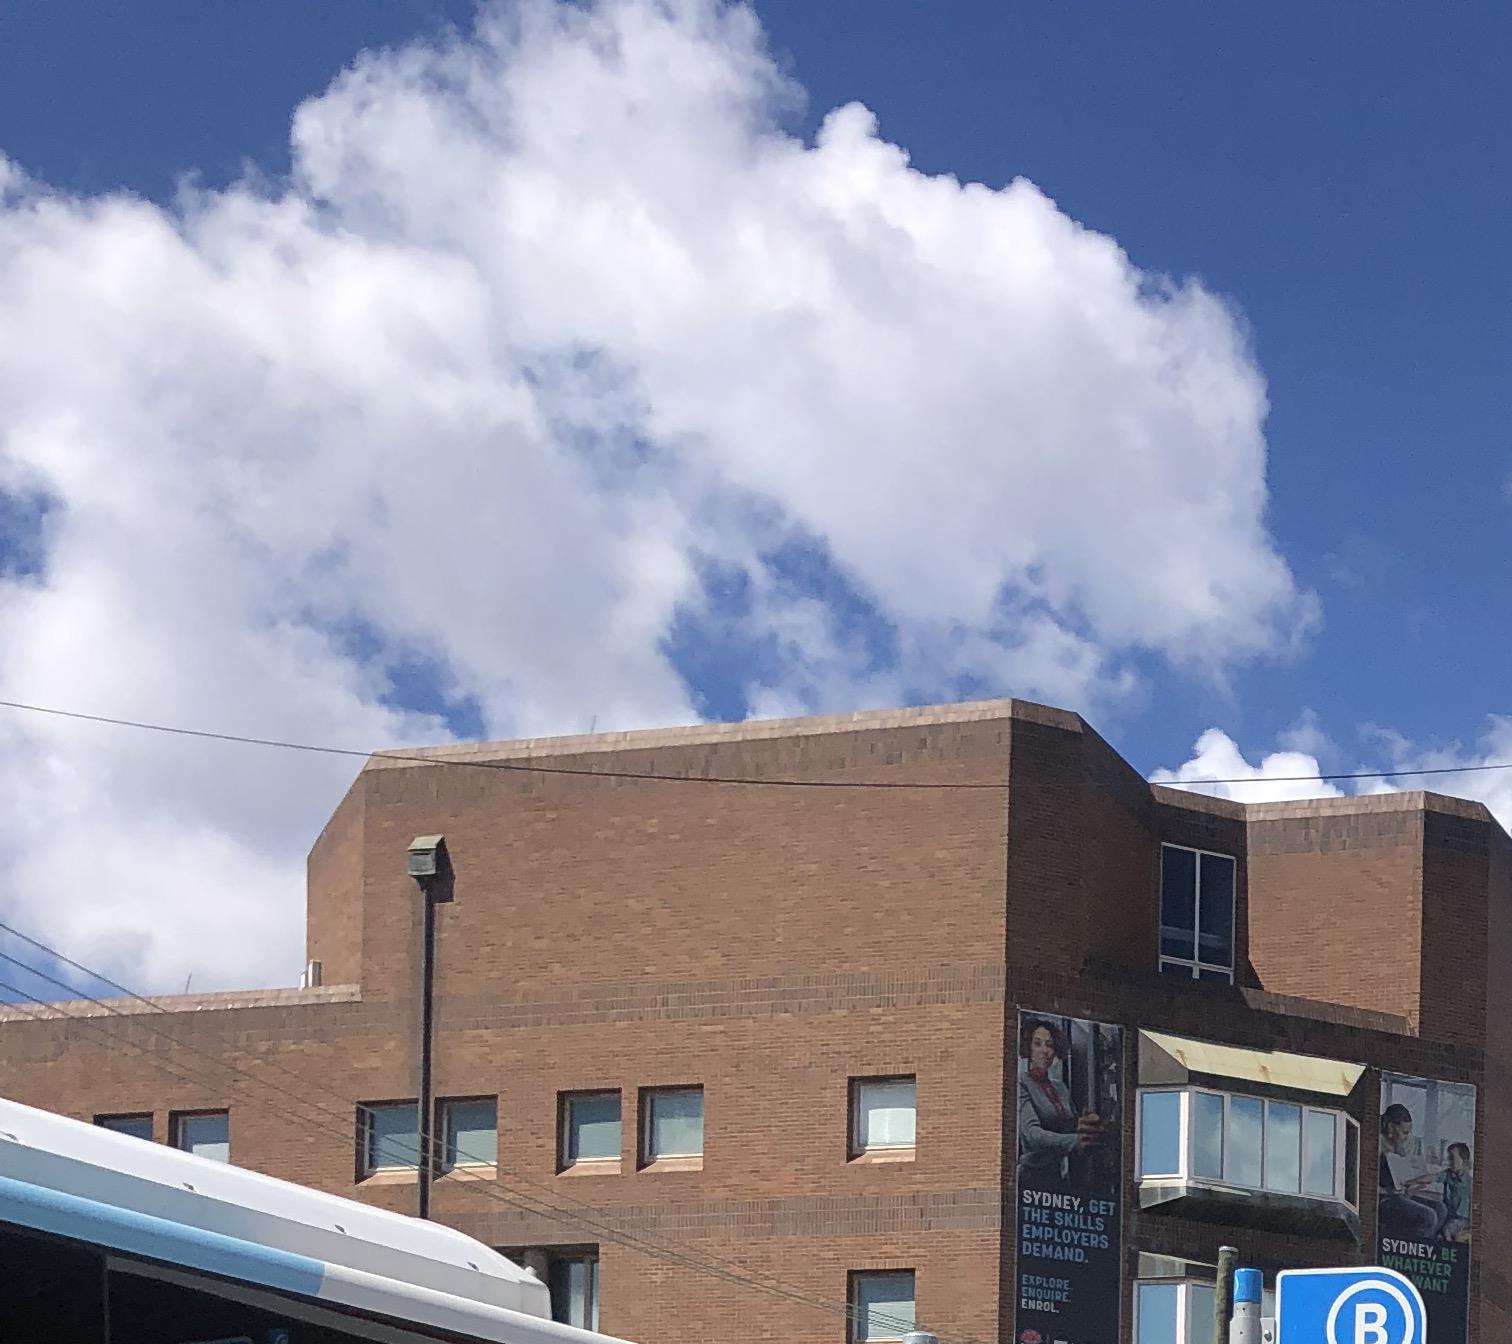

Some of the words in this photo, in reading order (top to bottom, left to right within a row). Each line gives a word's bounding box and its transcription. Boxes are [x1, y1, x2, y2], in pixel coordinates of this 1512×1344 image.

[1022, 1189, 1085, 1213] SYDNEY,
[1088, 1199, 1116, 1216] GET
[1022, 1206, 1050, 1224] THE
[1054, 1211, 1105, 1231] SKILLS
[1022, 1224, 1109, 1249] EMPLOYERS
[1022, 1241, 1089, 1263] DEMAND.
[1382, 1238, 1437, 1260] SYDNEY,
[1441, 1248, 1457, 1262] BE
[1381, 1254, 1452, 1278] WHATEVER
